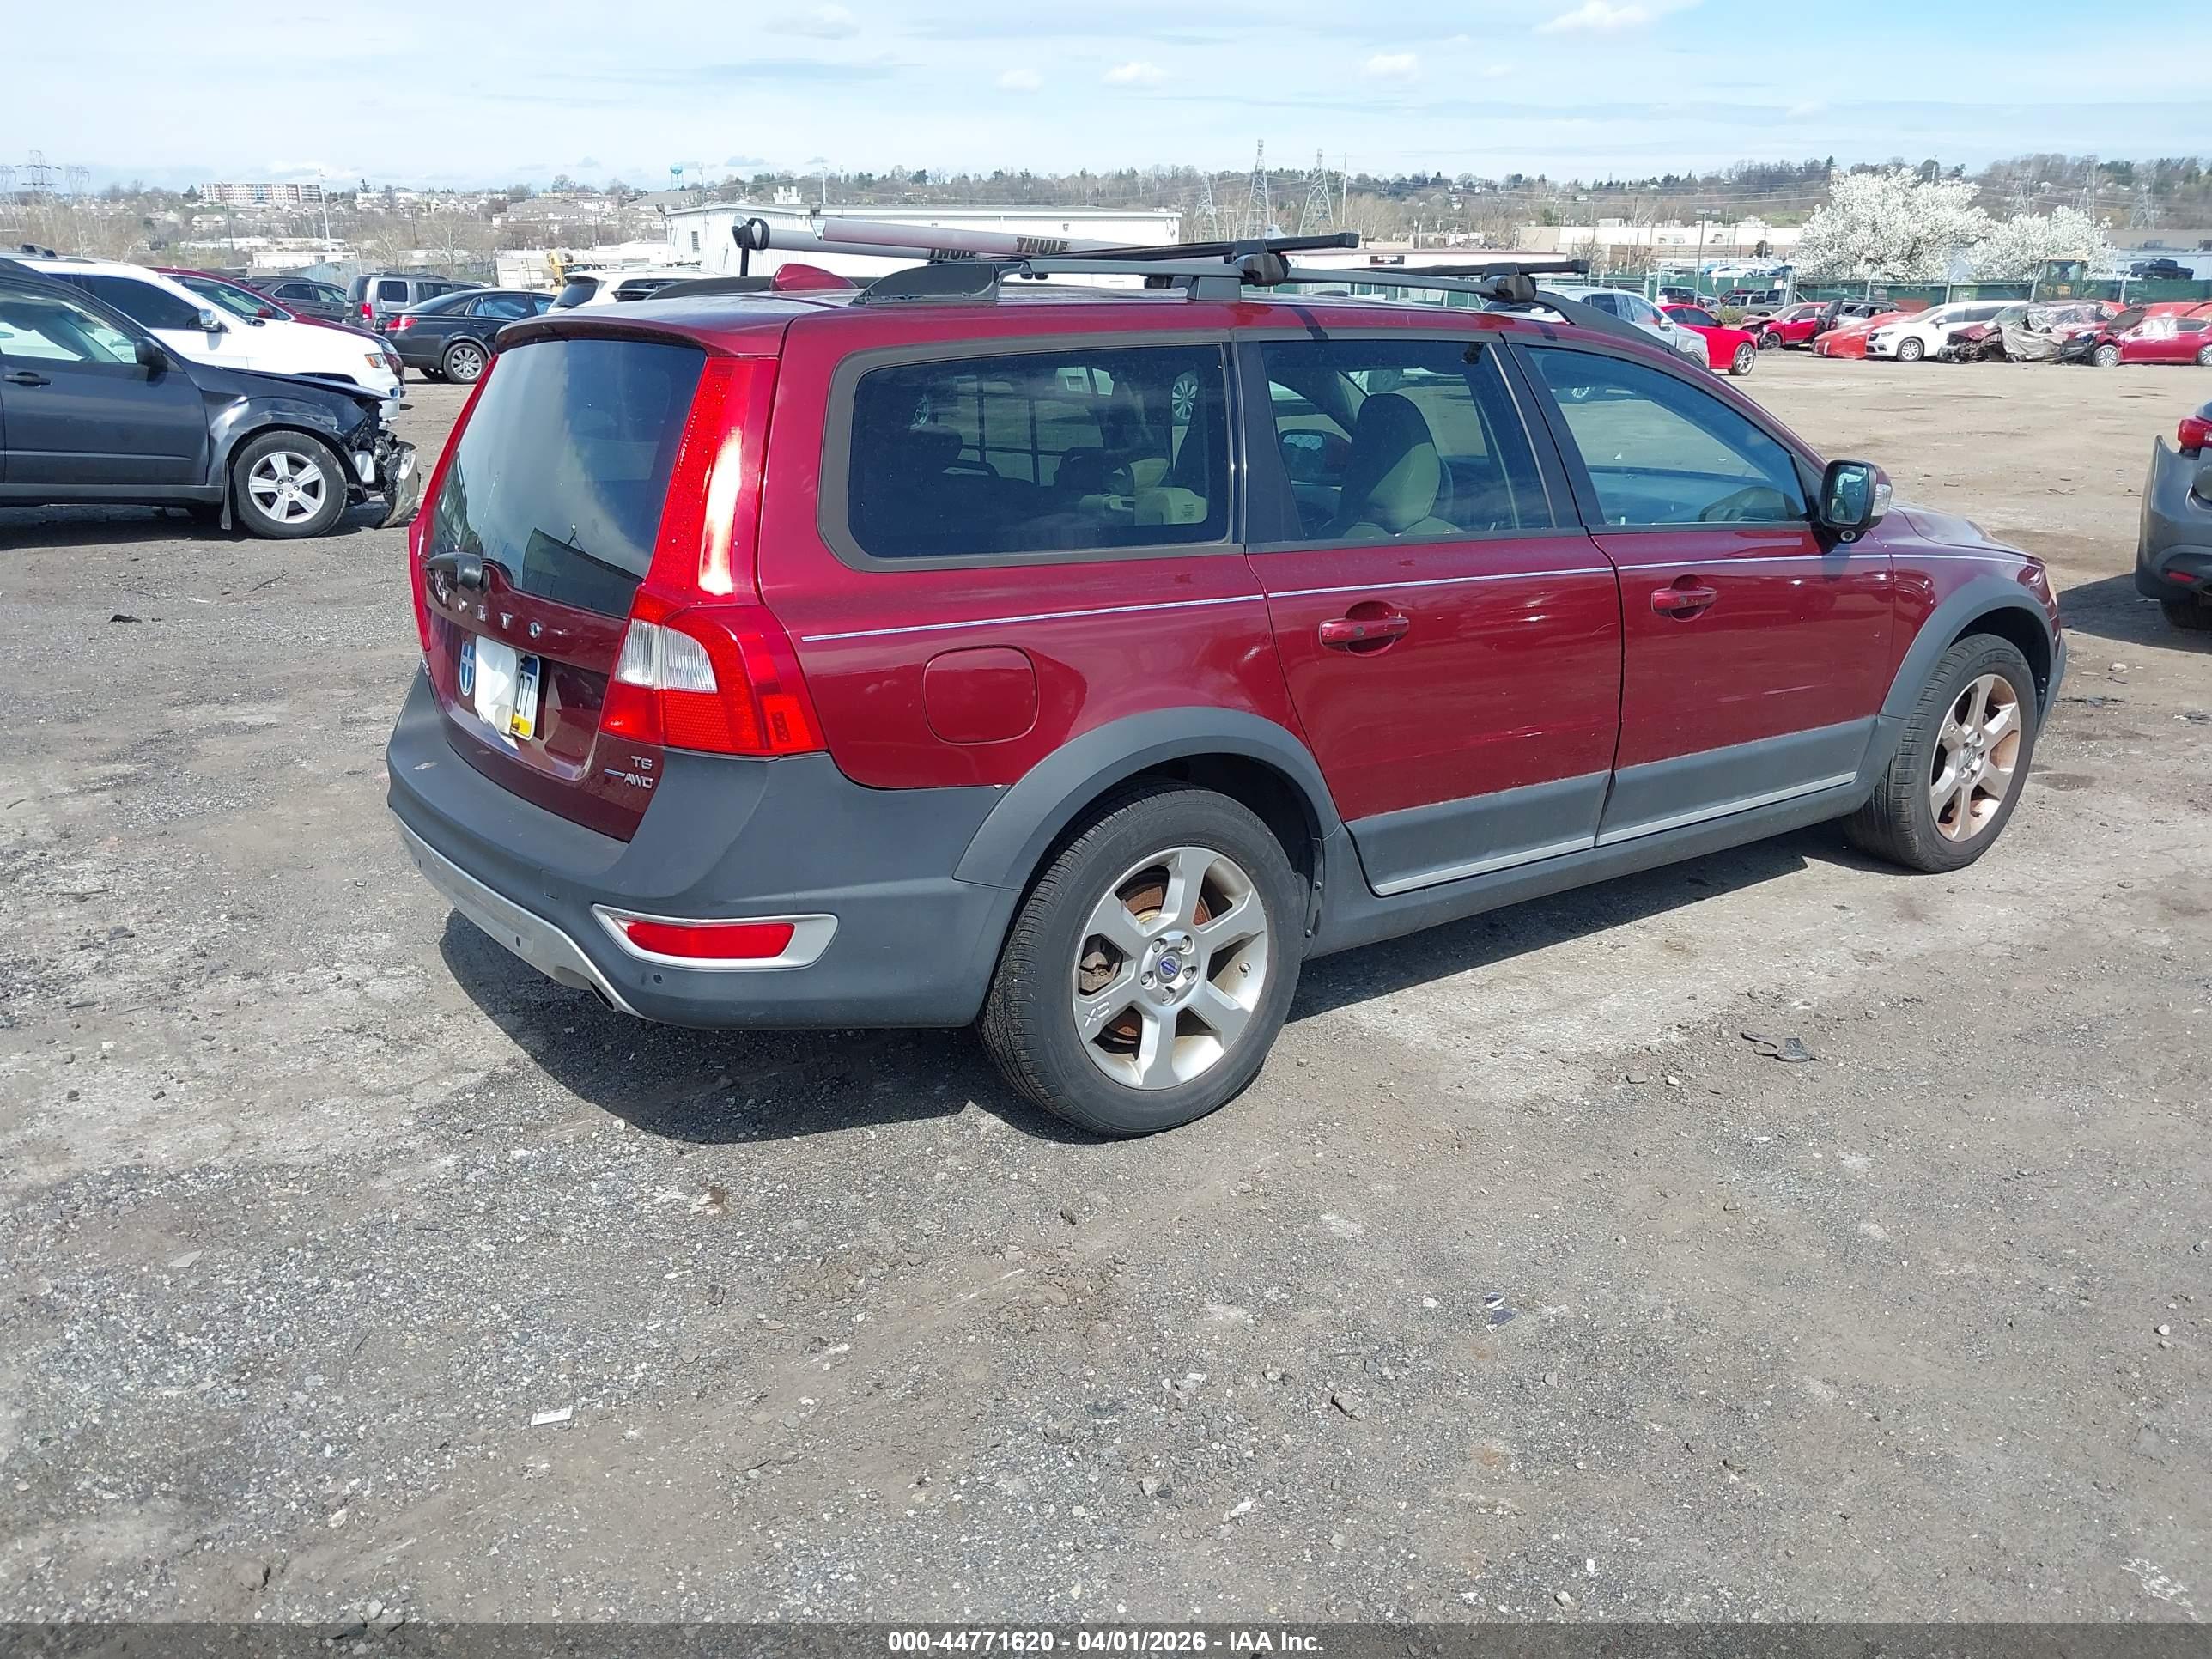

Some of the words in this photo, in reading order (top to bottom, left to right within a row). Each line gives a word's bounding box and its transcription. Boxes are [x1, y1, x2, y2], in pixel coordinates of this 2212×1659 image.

[1016, 236, 1070, 254] THULE
[441, 588, 542, 639] VOLVO
[623, 773, 653, 789] AWD
